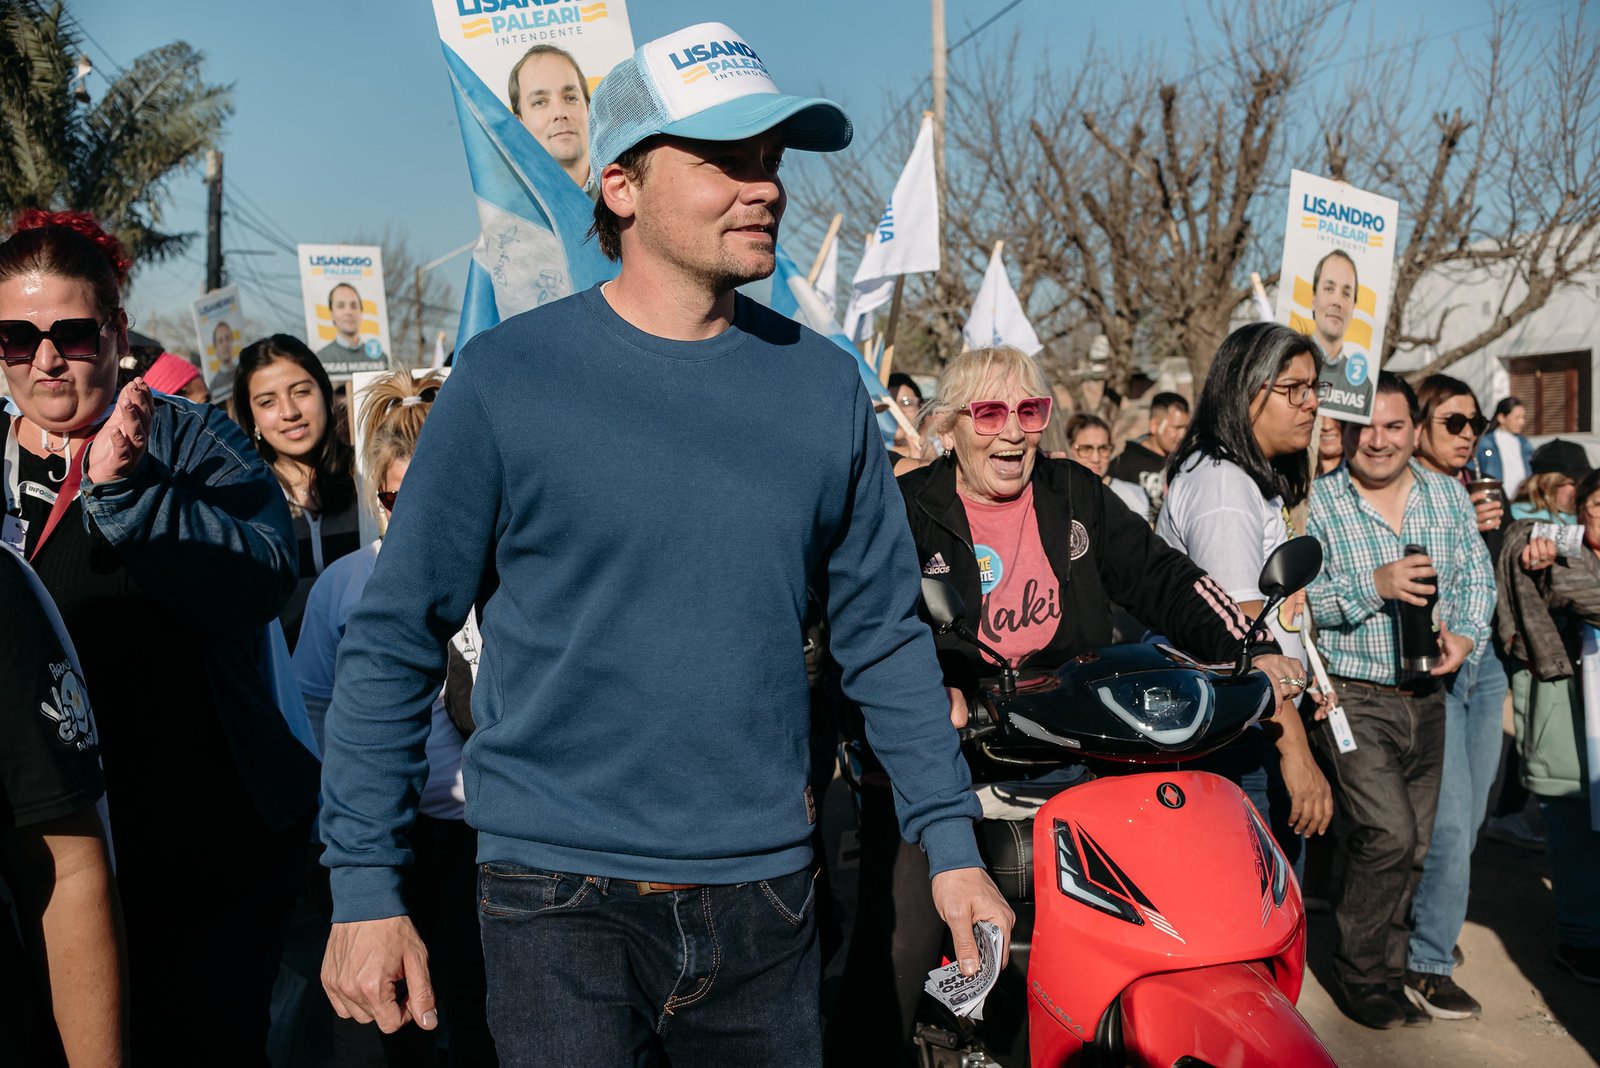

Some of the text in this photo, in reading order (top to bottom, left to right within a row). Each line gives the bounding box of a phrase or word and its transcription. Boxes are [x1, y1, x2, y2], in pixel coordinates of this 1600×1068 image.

[491, 5, 581, 33] PALEARI
[496, 25, 583, 46] INTENDENTE
[668, 40, 763, 70] LISAND
[706, 57, 768, 74] PALEA
[1303, 193, 1385, 233] LISANDRO
[1318, 219, 1369, 244] PALEARI
[1317, 234, 1367, 254] INTENDENTE
[309, 255, 373, 267] LISANDRO
[1351, 365, 1362, 380] 2
[1326, 388, 1366, 409] UEVAS
[923, 565, 950, 575] adidas
[977, 555, 991, 571] TE
